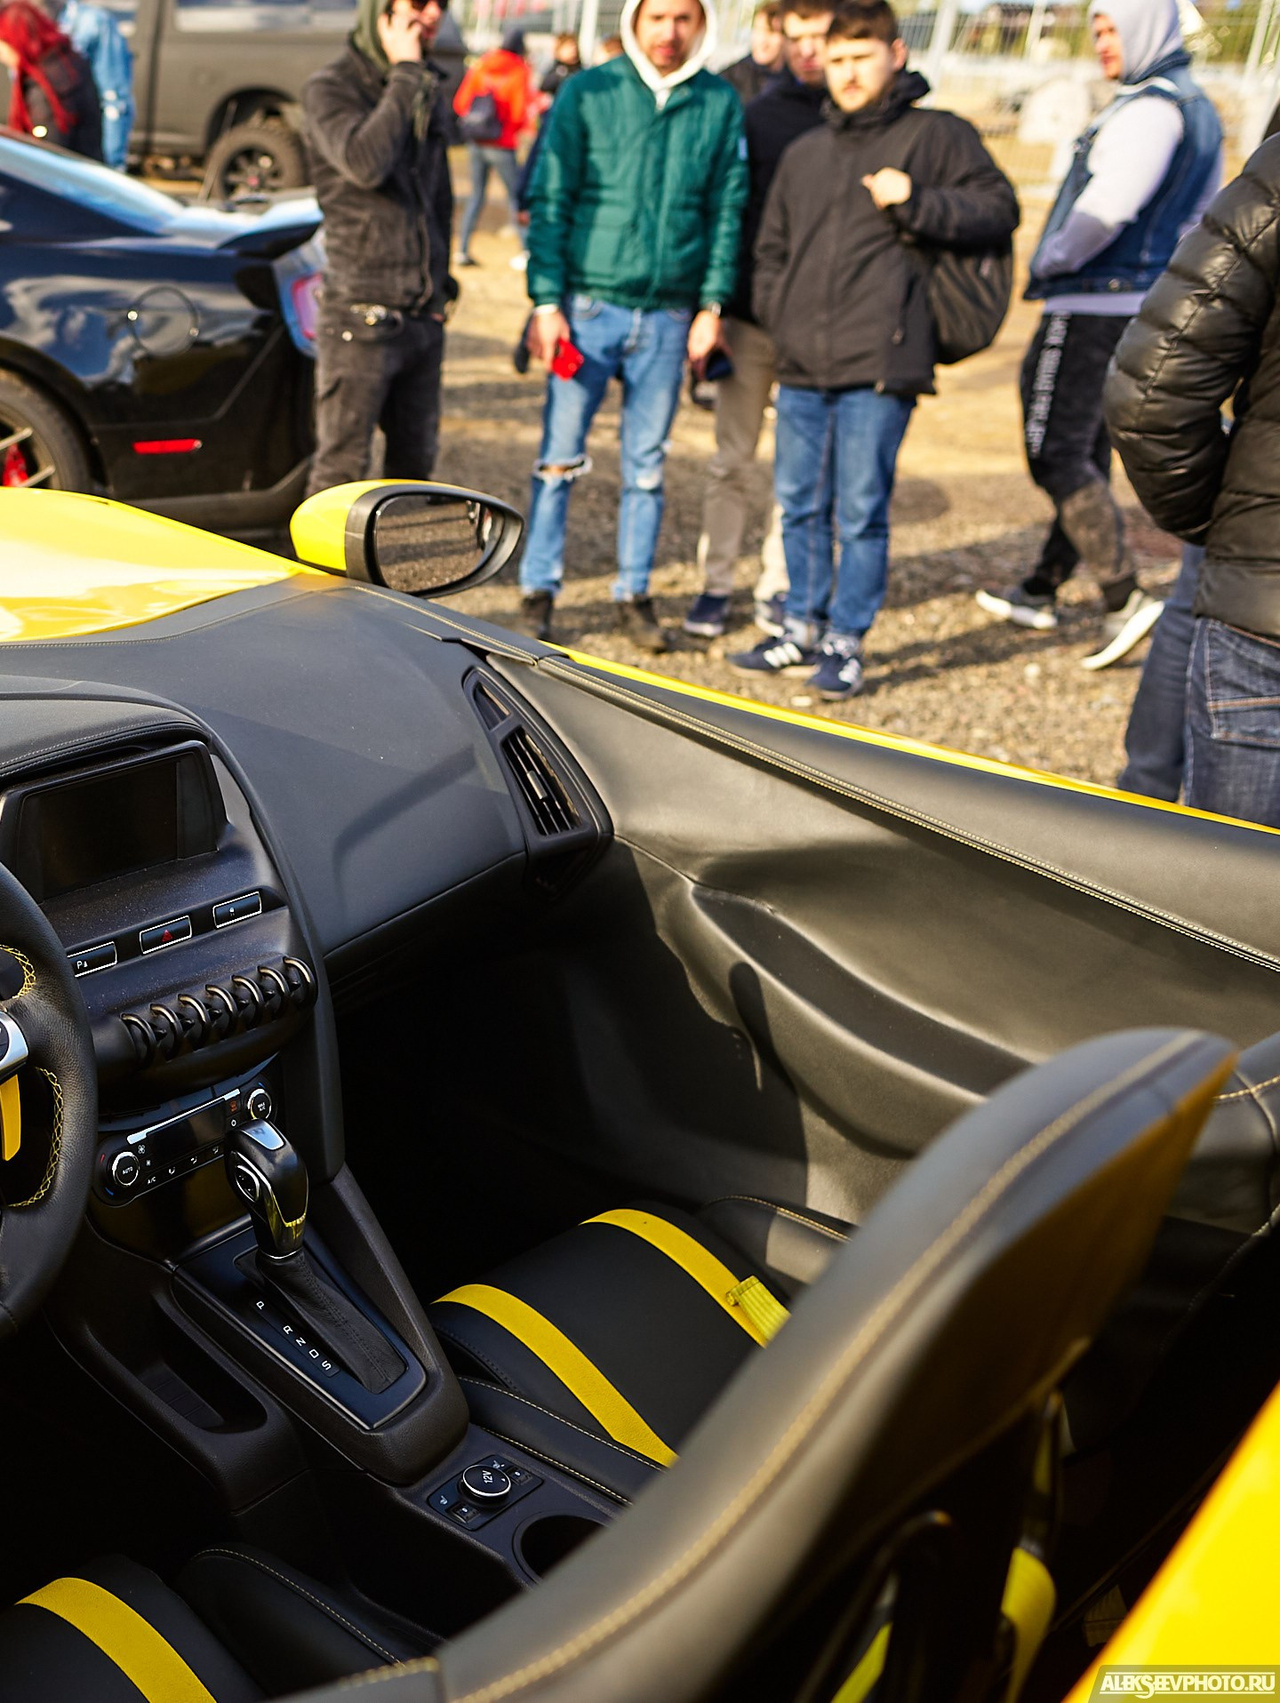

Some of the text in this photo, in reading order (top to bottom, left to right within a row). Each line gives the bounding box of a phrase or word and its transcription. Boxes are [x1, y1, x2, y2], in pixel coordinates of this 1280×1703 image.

[147, 1176, 157, 1185] A/C
[256, 1301, 332, 1371] P R N D S
[482, 1470, 494, 1484] 12V
